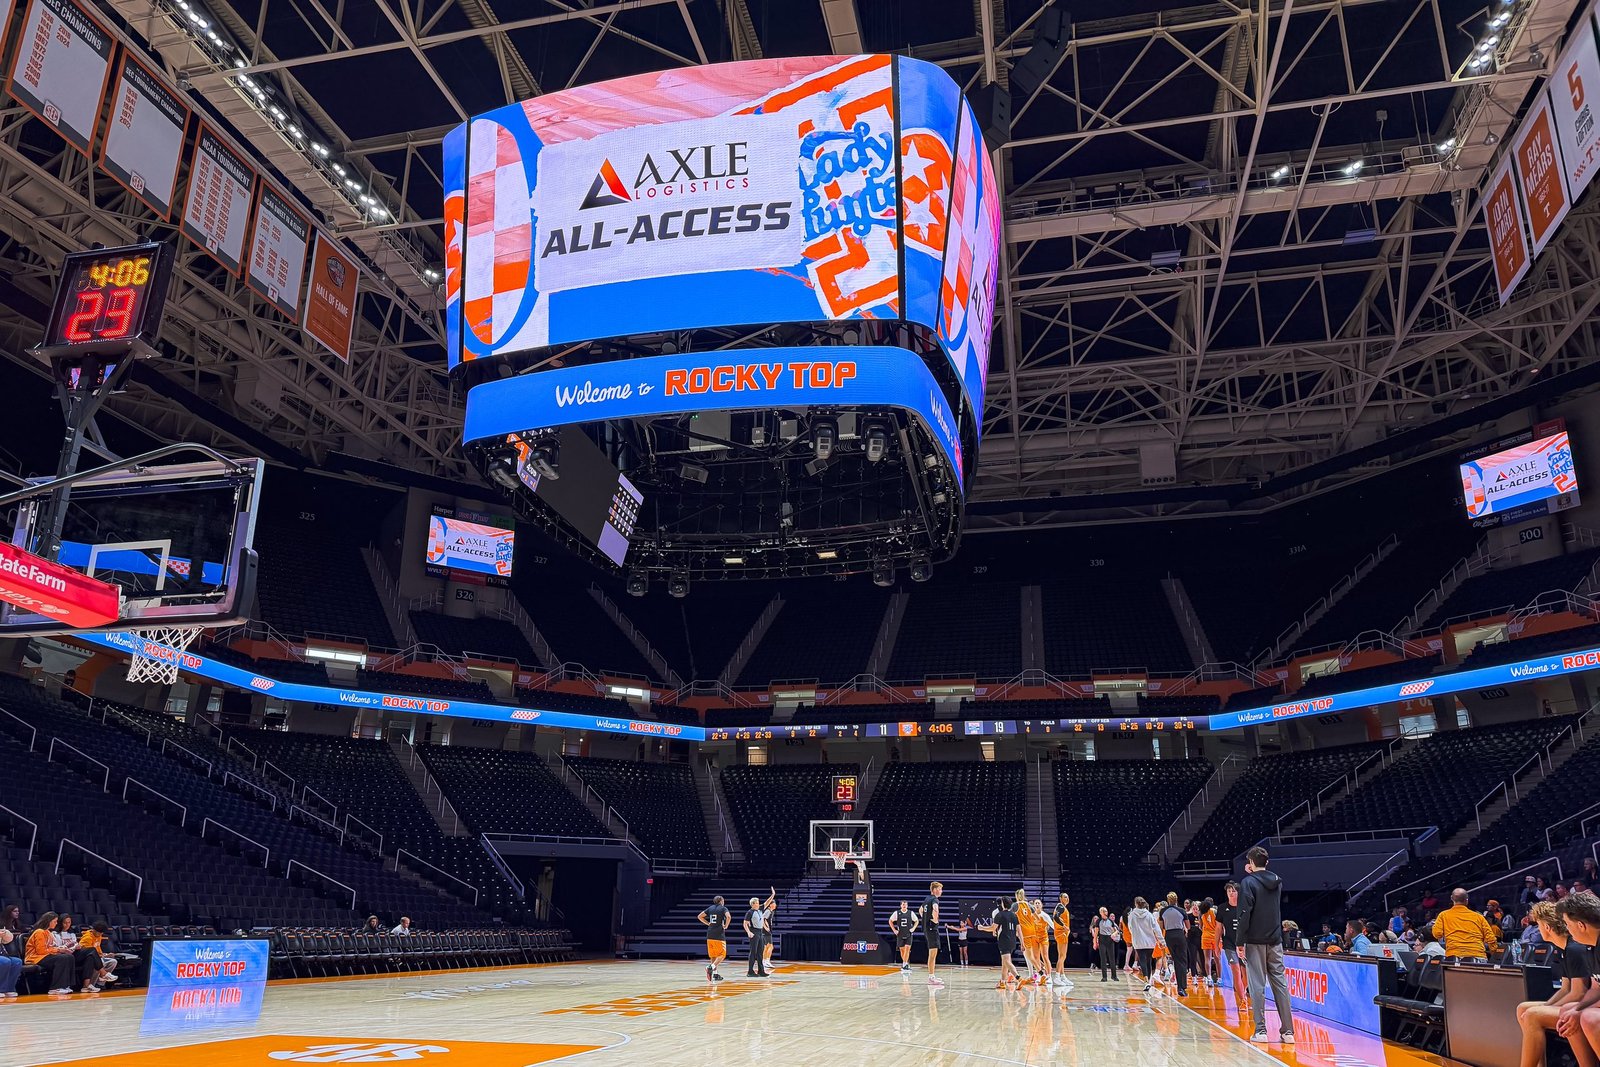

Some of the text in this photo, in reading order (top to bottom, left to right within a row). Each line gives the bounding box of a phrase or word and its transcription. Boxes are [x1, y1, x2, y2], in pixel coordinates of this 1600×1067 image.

[60, 7, 102, 51] CHAMPIONS
[56, 32, 70, 48] 2024
[31, 48, 44, 63] 1977
[33, 41, 47, 56] 1972
[134, 74, 161, 104] TOURNAMENT
[1567, 60, 1585, 112] 5
[1574, 103, 1591, 133] CHRIS
[1575, 112, 1595, 148] LOFTON
[1526, 130, 1543, 169] RAY
[202, 137, 250, 187] NCAA TOURNAMENT
[634, 142, 749, 190] AXLE
[1526, 143, 1553, 198] MEARS
[635, 177, 750, 200] LOGISTICS
[541, 201, 792, 259] ALL-ACCESS
[209, 237, 217, 249] T
[91, 257, 150, 288] 4:06
[315, 282, 329, 302] HALL
[328, 294, 336, 308] OF
[335, 300, 349, 319] FAME
[66, 288, 137, 341] 23
[556, 361, 857, 408] Welcome to ROCKY TOP
[1508, 460, 1537, 477] AXLE
[1487, 470, 1549, 495] ALL-ACCESS
[299, 511, 316, 521] 325
[465, 537, 488, 548] AXLE
[1520, 528, 1541, 542] 300
[446, 544, 495, 559] ALL-ACCESS
[534, 555, 548, 565] 327
[1089, 559, 1105, 567] 330
[0, 553, 66, 592] tateFarm
[973, 566, 988, 574] 329
[456, 589, 474, 601] 326
[182, 653, 202, 670] TOP
[1511, 664, 1549, 678] Welcome
[1550, 663, 1559, 671] to
[1485, 689, 1504, 699] 100
[339, 691, 371, 705] Welcome
[382, 695, 425, 711] ROCKY
[425, 700, 450, 713] TOP
[1238, 711, 1264, 723] Welcome
[1272, 702, 1310, 719] ROCKY
[1311, 698, 1334, 712] TOP
[596, 718, 621, 730] Welcome
[629, 721, 662, 734] ROCKY
[662, 725, 682, 736] TOP
[809, 729, 816, 737] 22
[880, 724, 887, 736] 11
[928, 723, 954, 733] 4:06
[994, 721, 1004, 733] 19
[1074, 724, 1082, 732] 32
[1098, 723, 1104, 731] 13
[839, 778, 855, 786] 4:06
[837, 786, 853, 799] 23
[710, 914, 718, 924] 12
[901, 918, 908, 927] 2
[1008, 922, 1015, 930] 11
[195, 947, 224, 961] Welcome
[843, 942, 857, 951] FOOD
[176, 961, 246, 979] ROCKY TOP
[1284, 967, 1328, 1005] OCKY TOP
